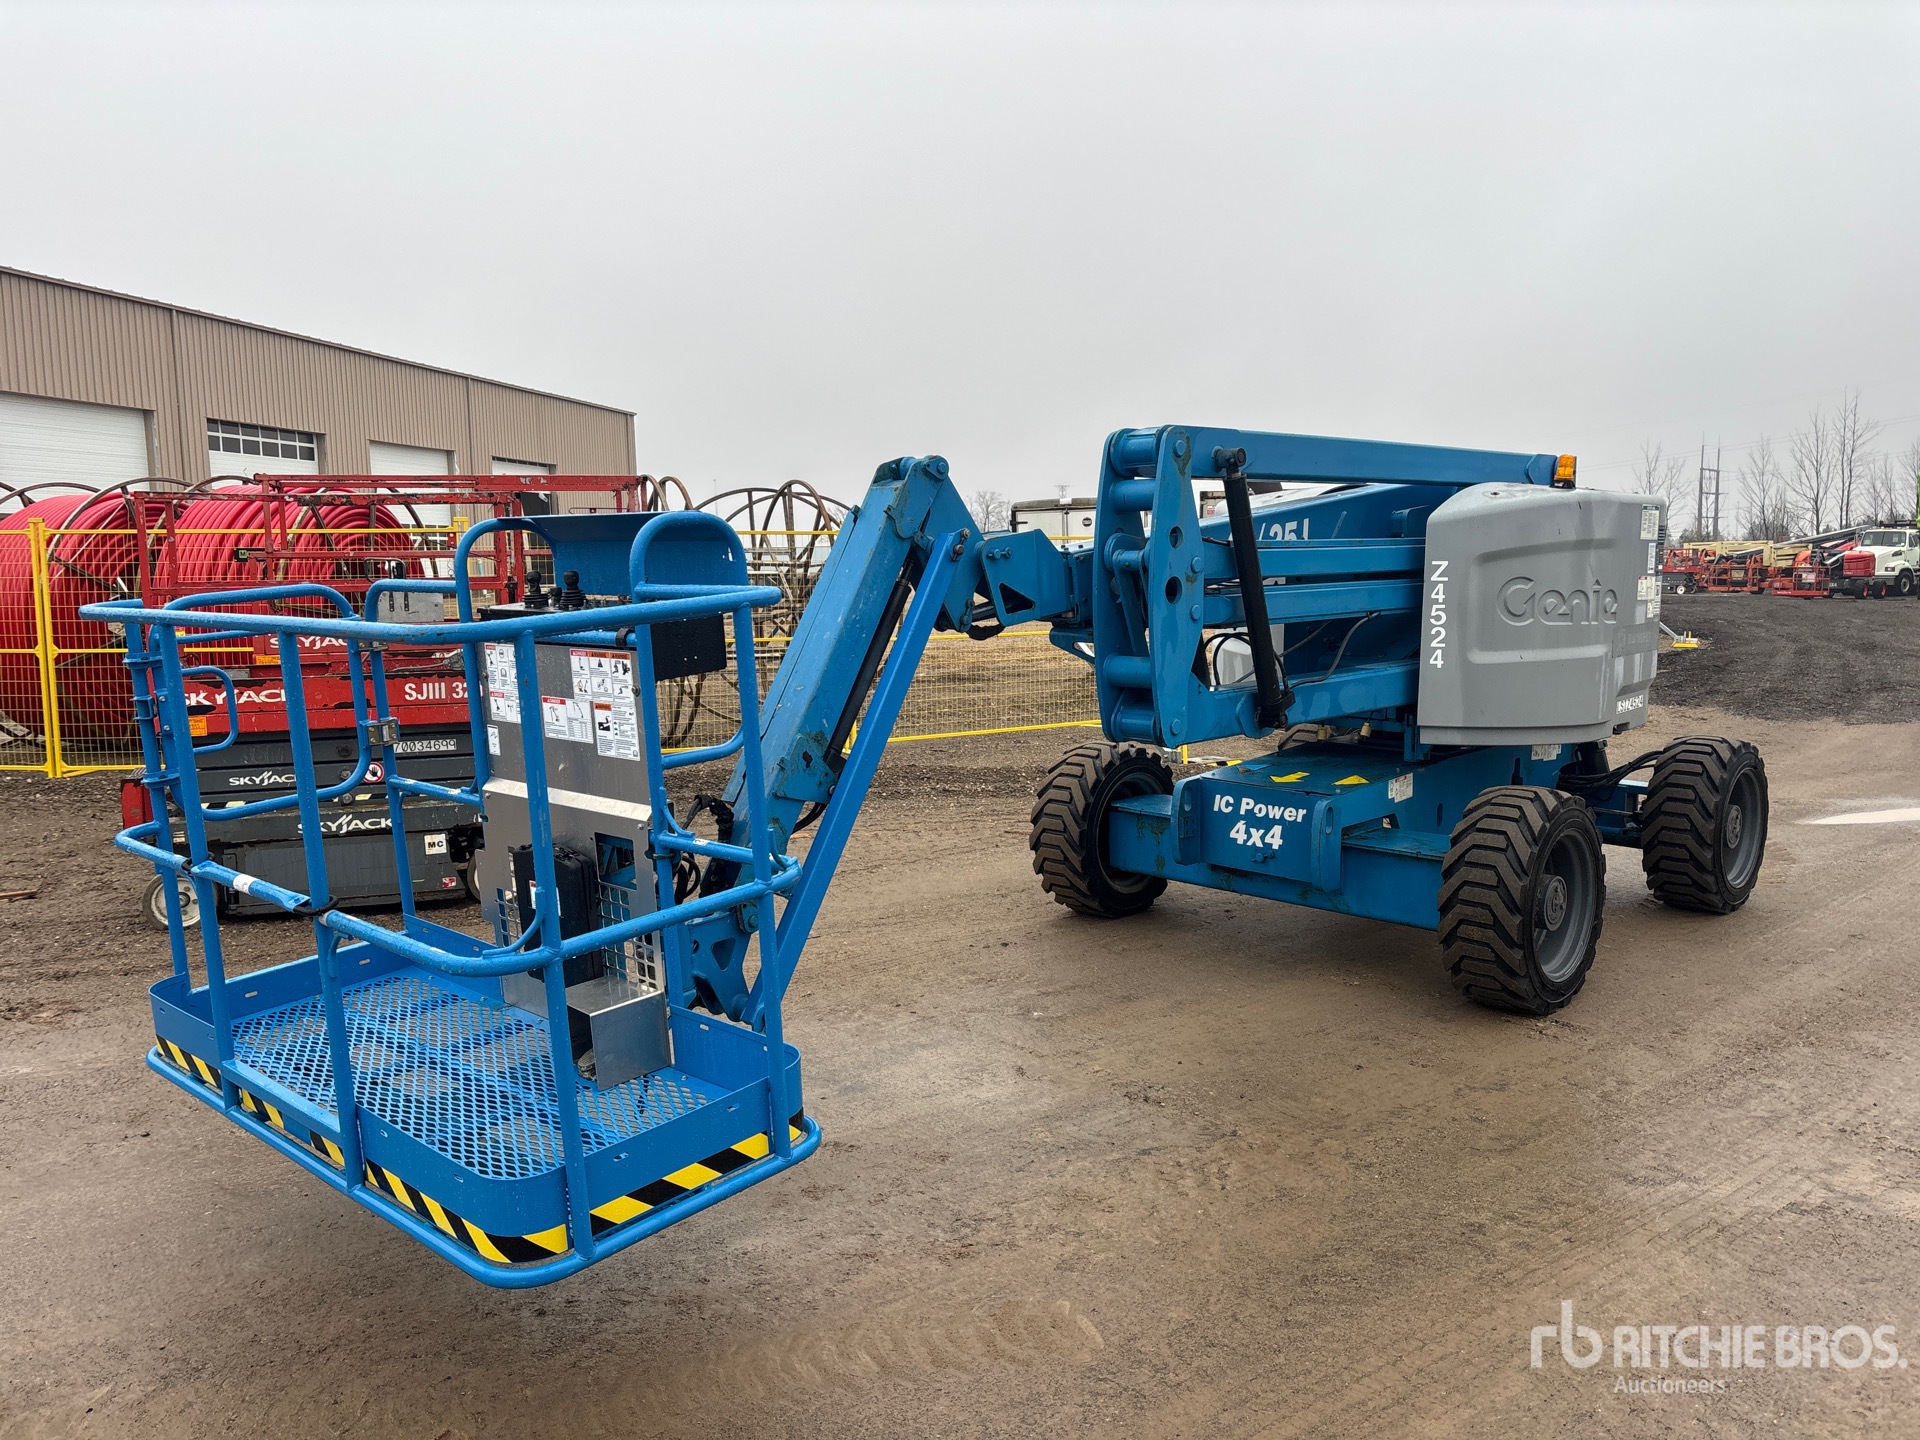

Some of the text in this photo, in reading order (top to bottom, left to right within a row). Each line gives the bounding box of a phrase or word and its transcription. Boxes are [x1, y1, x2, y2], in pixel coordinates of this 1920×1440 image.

[1497, 576, 1618, 626] Genie
[1429, 560, 1449, 669] Z4524
[404, 682, 446, 701] SJIII
[395, 739, 456, 753] 70034699
[228, 770, 297, 786] SKYJAC
[1213, 794, 1307, 823] IC Power
[427, 840, 444, 849] MC
[1229, 820, 1283, 850] 4x4
